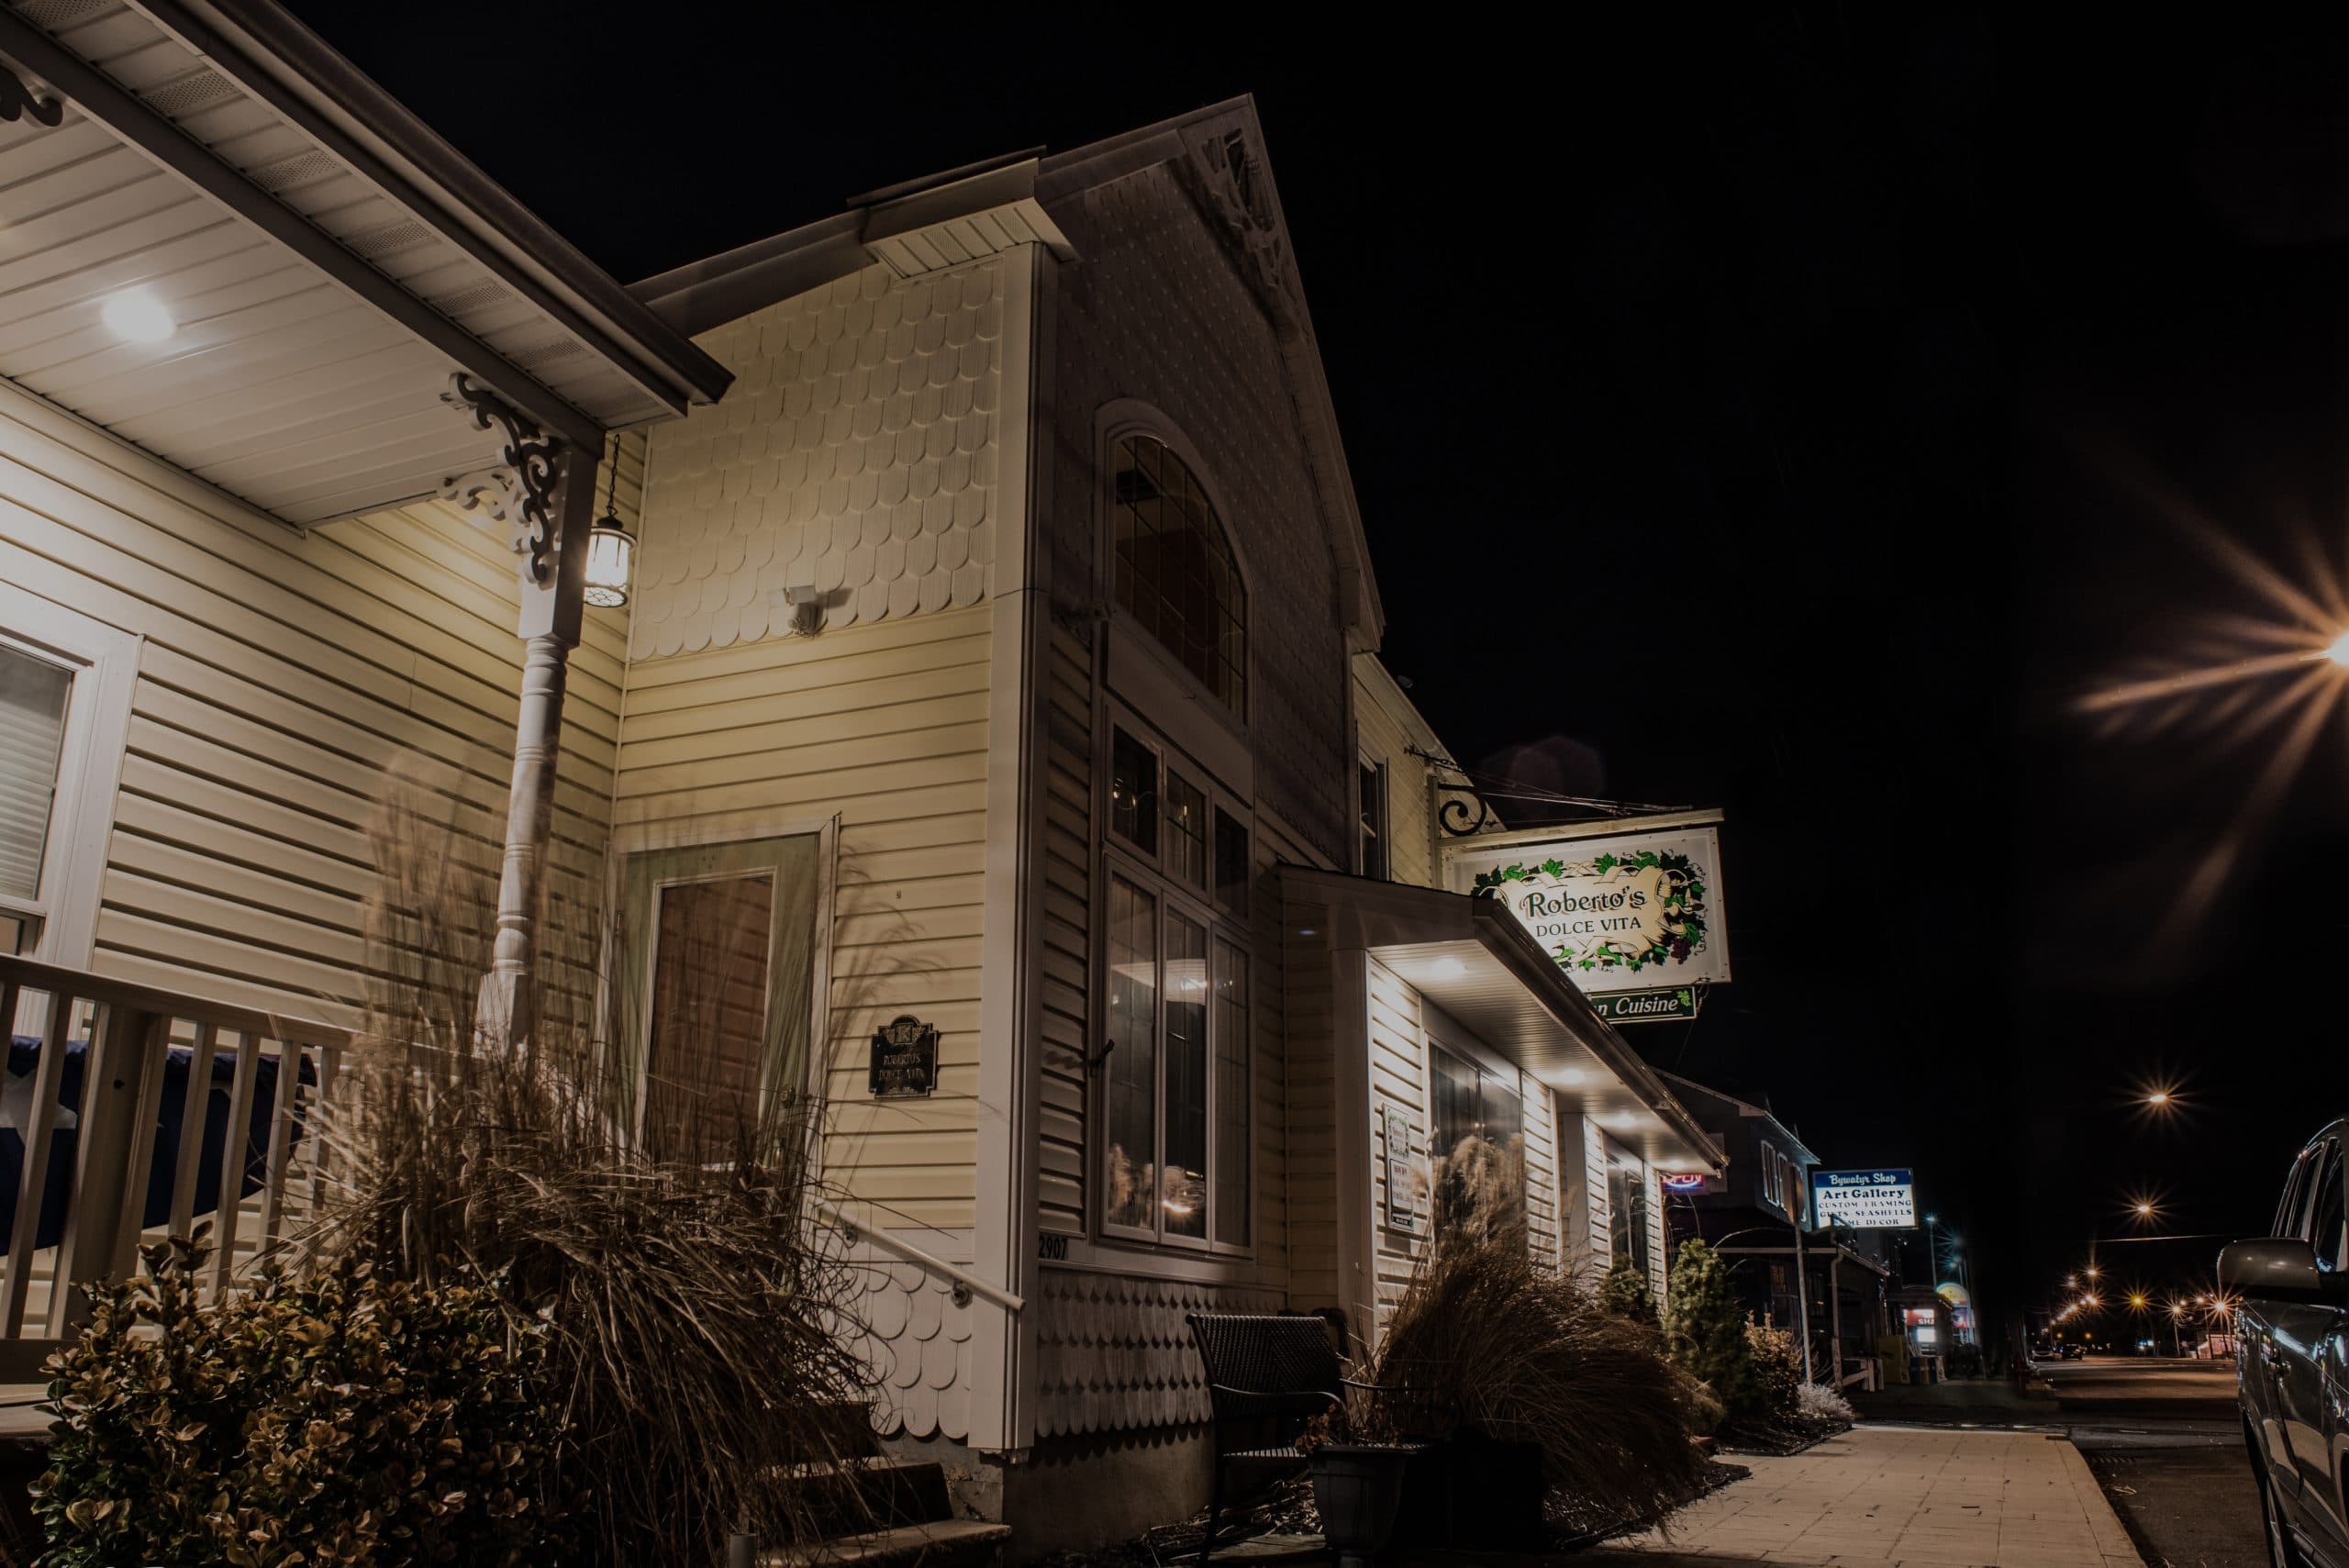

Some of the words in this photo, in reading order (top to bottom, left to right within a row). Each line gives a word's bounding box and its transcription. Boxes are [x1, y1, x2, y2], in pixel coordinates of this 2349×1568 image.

[1522, 884, 1646, 918] Roberto's
[1536, 920, 1595, 938] DOLCE
[1600, 917, 1642, 932] VITA
[1615, 996, 1678, 1016] Cuisine
[1873, 1173, 1897, 1184] Shop
[1823, 1190, 1849, 1200] Art
[1852, 1189, 1905, 1200] Gallery
[1865, 1199, 1912, 1207] FRAMING
[1039, 1235, 1067, 1260] 2907
